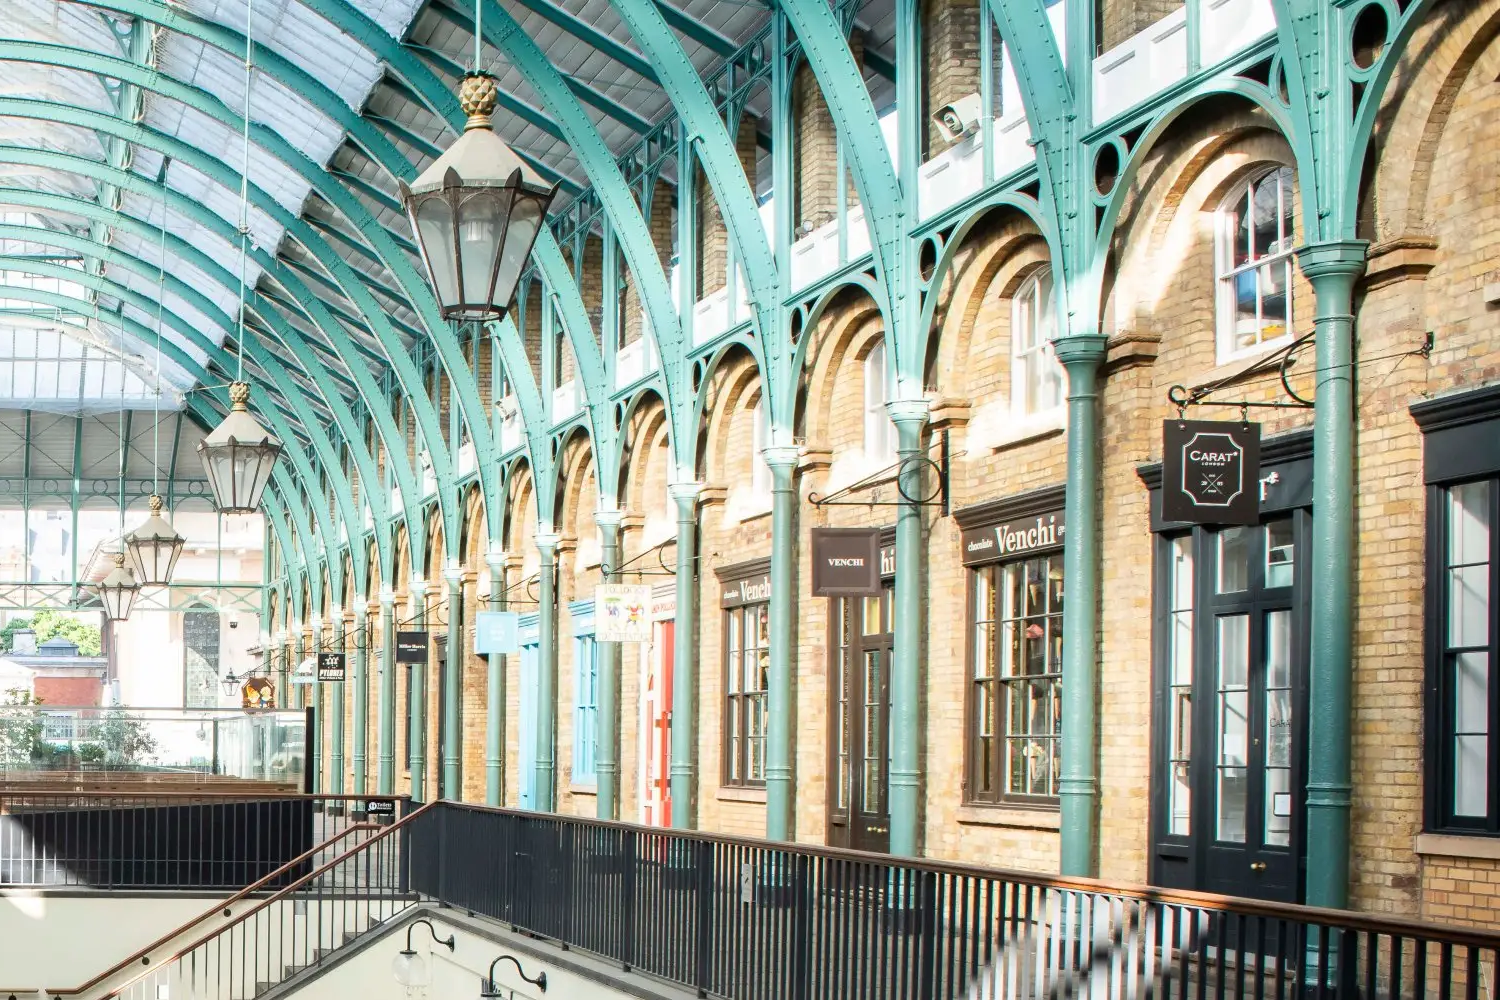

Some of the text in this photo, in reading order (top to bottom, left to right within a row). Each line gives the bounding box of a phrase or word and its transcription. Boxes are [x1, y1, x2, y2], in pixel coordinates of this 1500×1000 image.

[1190, 449, 1235, 462] CARAT
[994, 515, 1057, 554] Venchi
[827, 558, 865, 567] VENCHI
[739, 575, 771, 602] Vench
